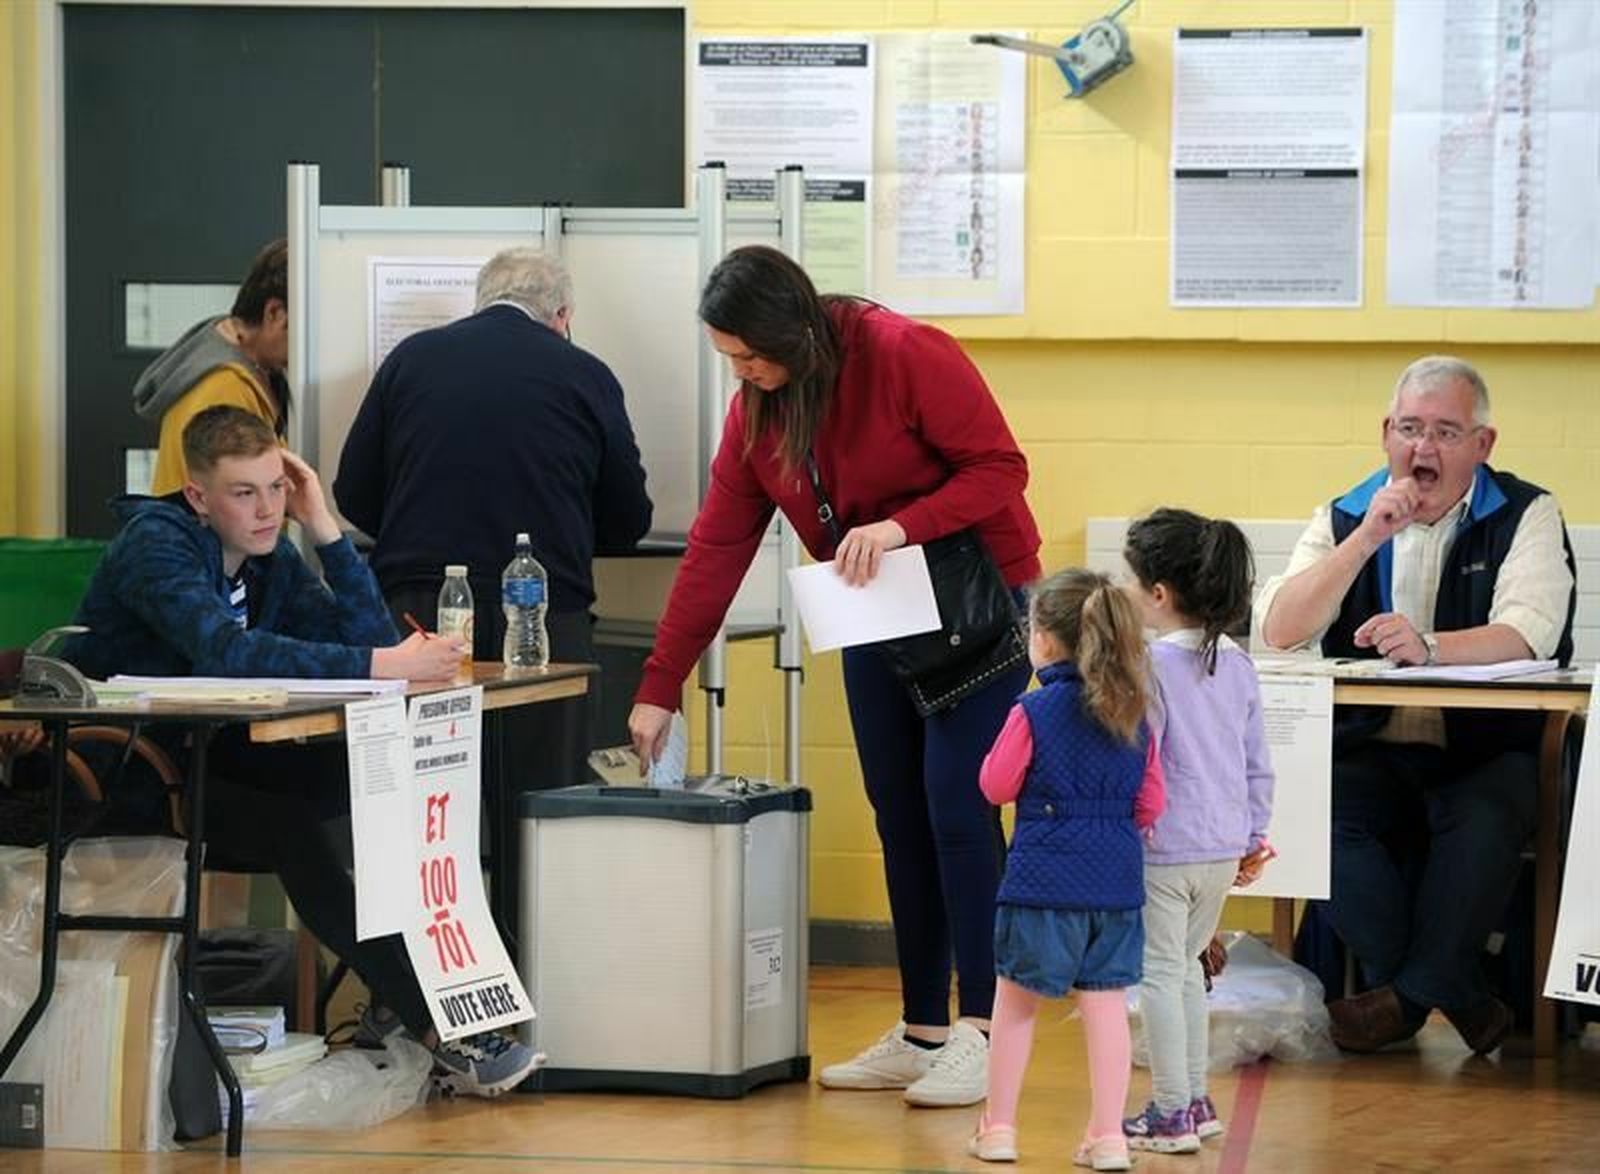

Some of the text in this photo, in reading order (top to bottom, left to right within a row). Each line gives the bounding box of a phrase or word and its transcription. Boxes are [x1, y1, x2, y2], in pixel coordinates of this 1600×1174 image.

[425, 793, 449, 843] ET
[420, 856, 458, 908] 100
[439, 983, 520, 1028] VOTE HERE
